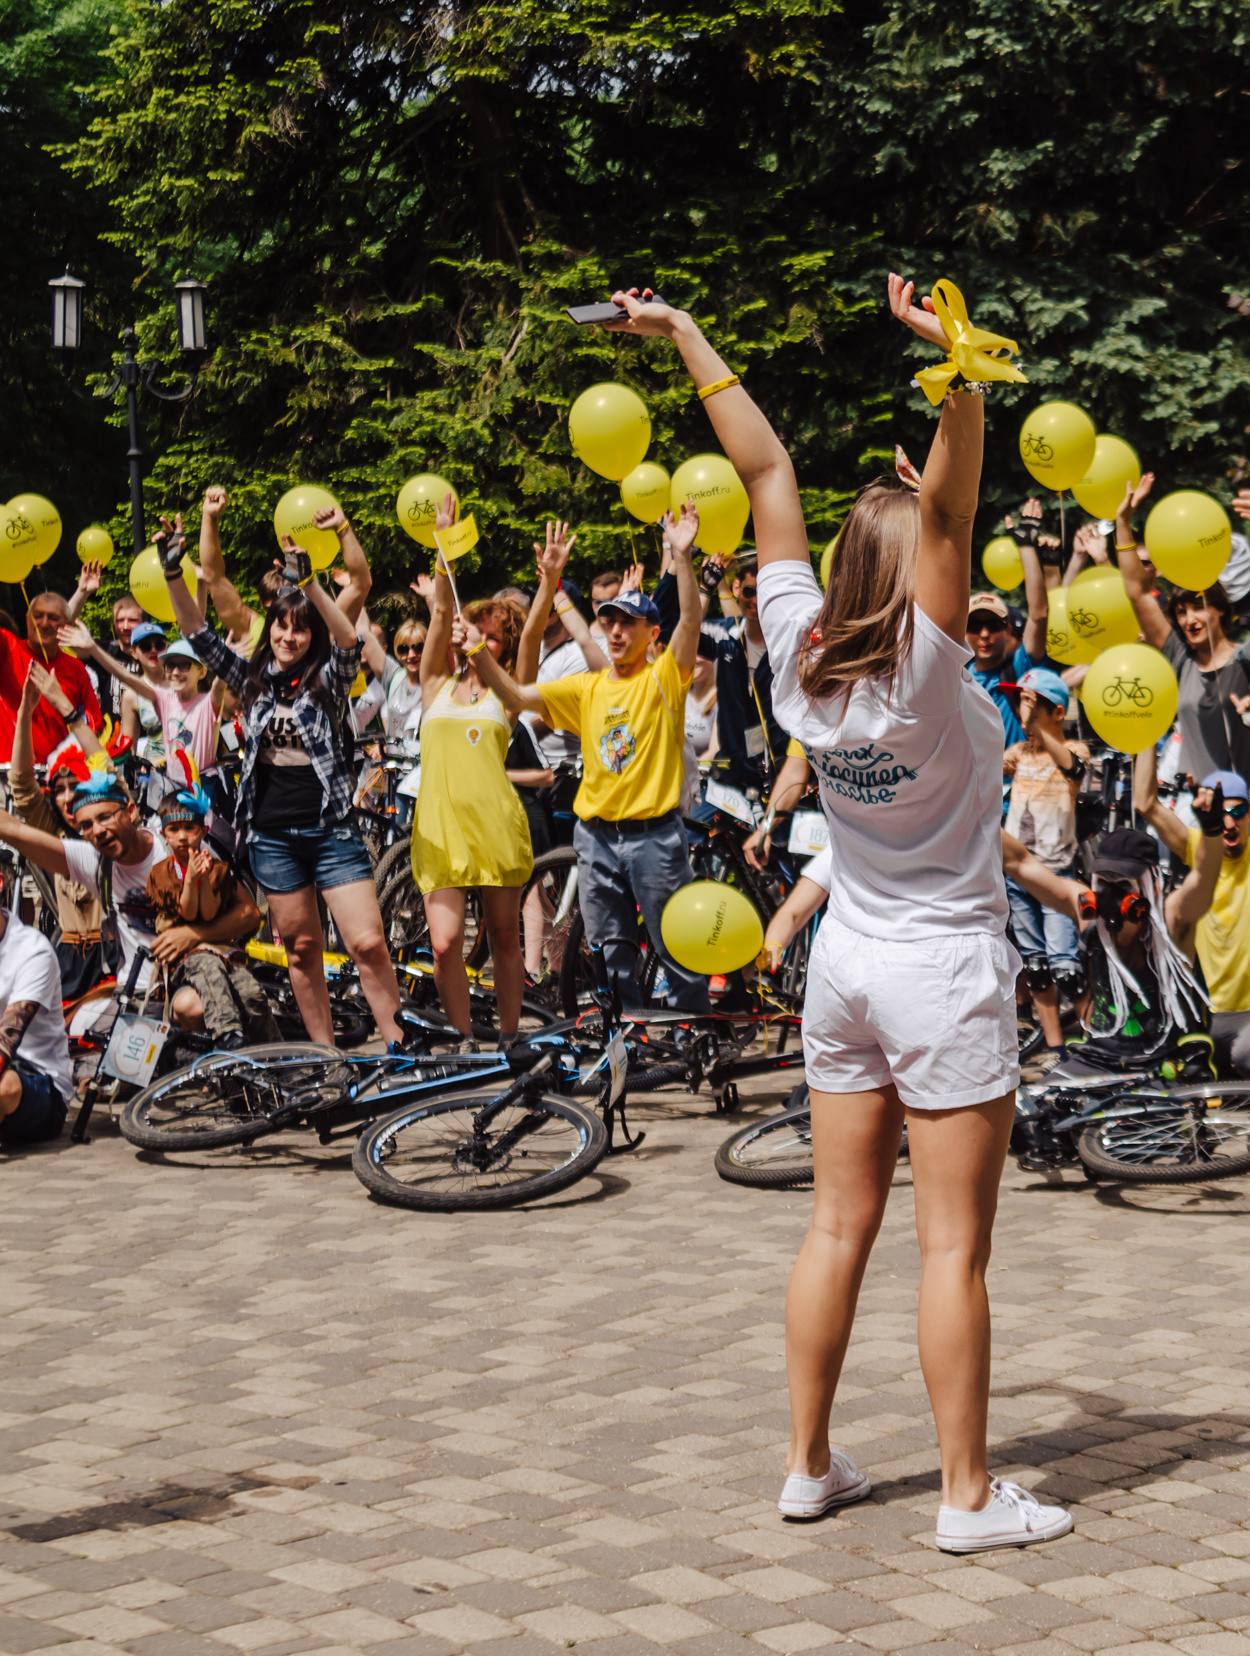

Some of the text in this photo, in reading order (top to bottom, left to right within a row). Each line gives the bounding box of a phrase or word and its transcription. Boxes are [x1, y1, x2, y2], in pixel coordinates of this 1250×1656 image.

[635, 488, 664, 499] Tinkoff.ru
[685, 486, 731, 501] Tinkoff.ru
[291, 521, 314, 535] Tinko
[447, 530, 472, 548] Tinkoff.ru
[1103, 710, 1152, 719] #tinkoffvelo
[722, 791, 740, 808] 170
[810, 827, 829, 844] 187
[706, 901, 727, 947] Tinkoff.ru
[123, 1035, 146, 1062] 146
